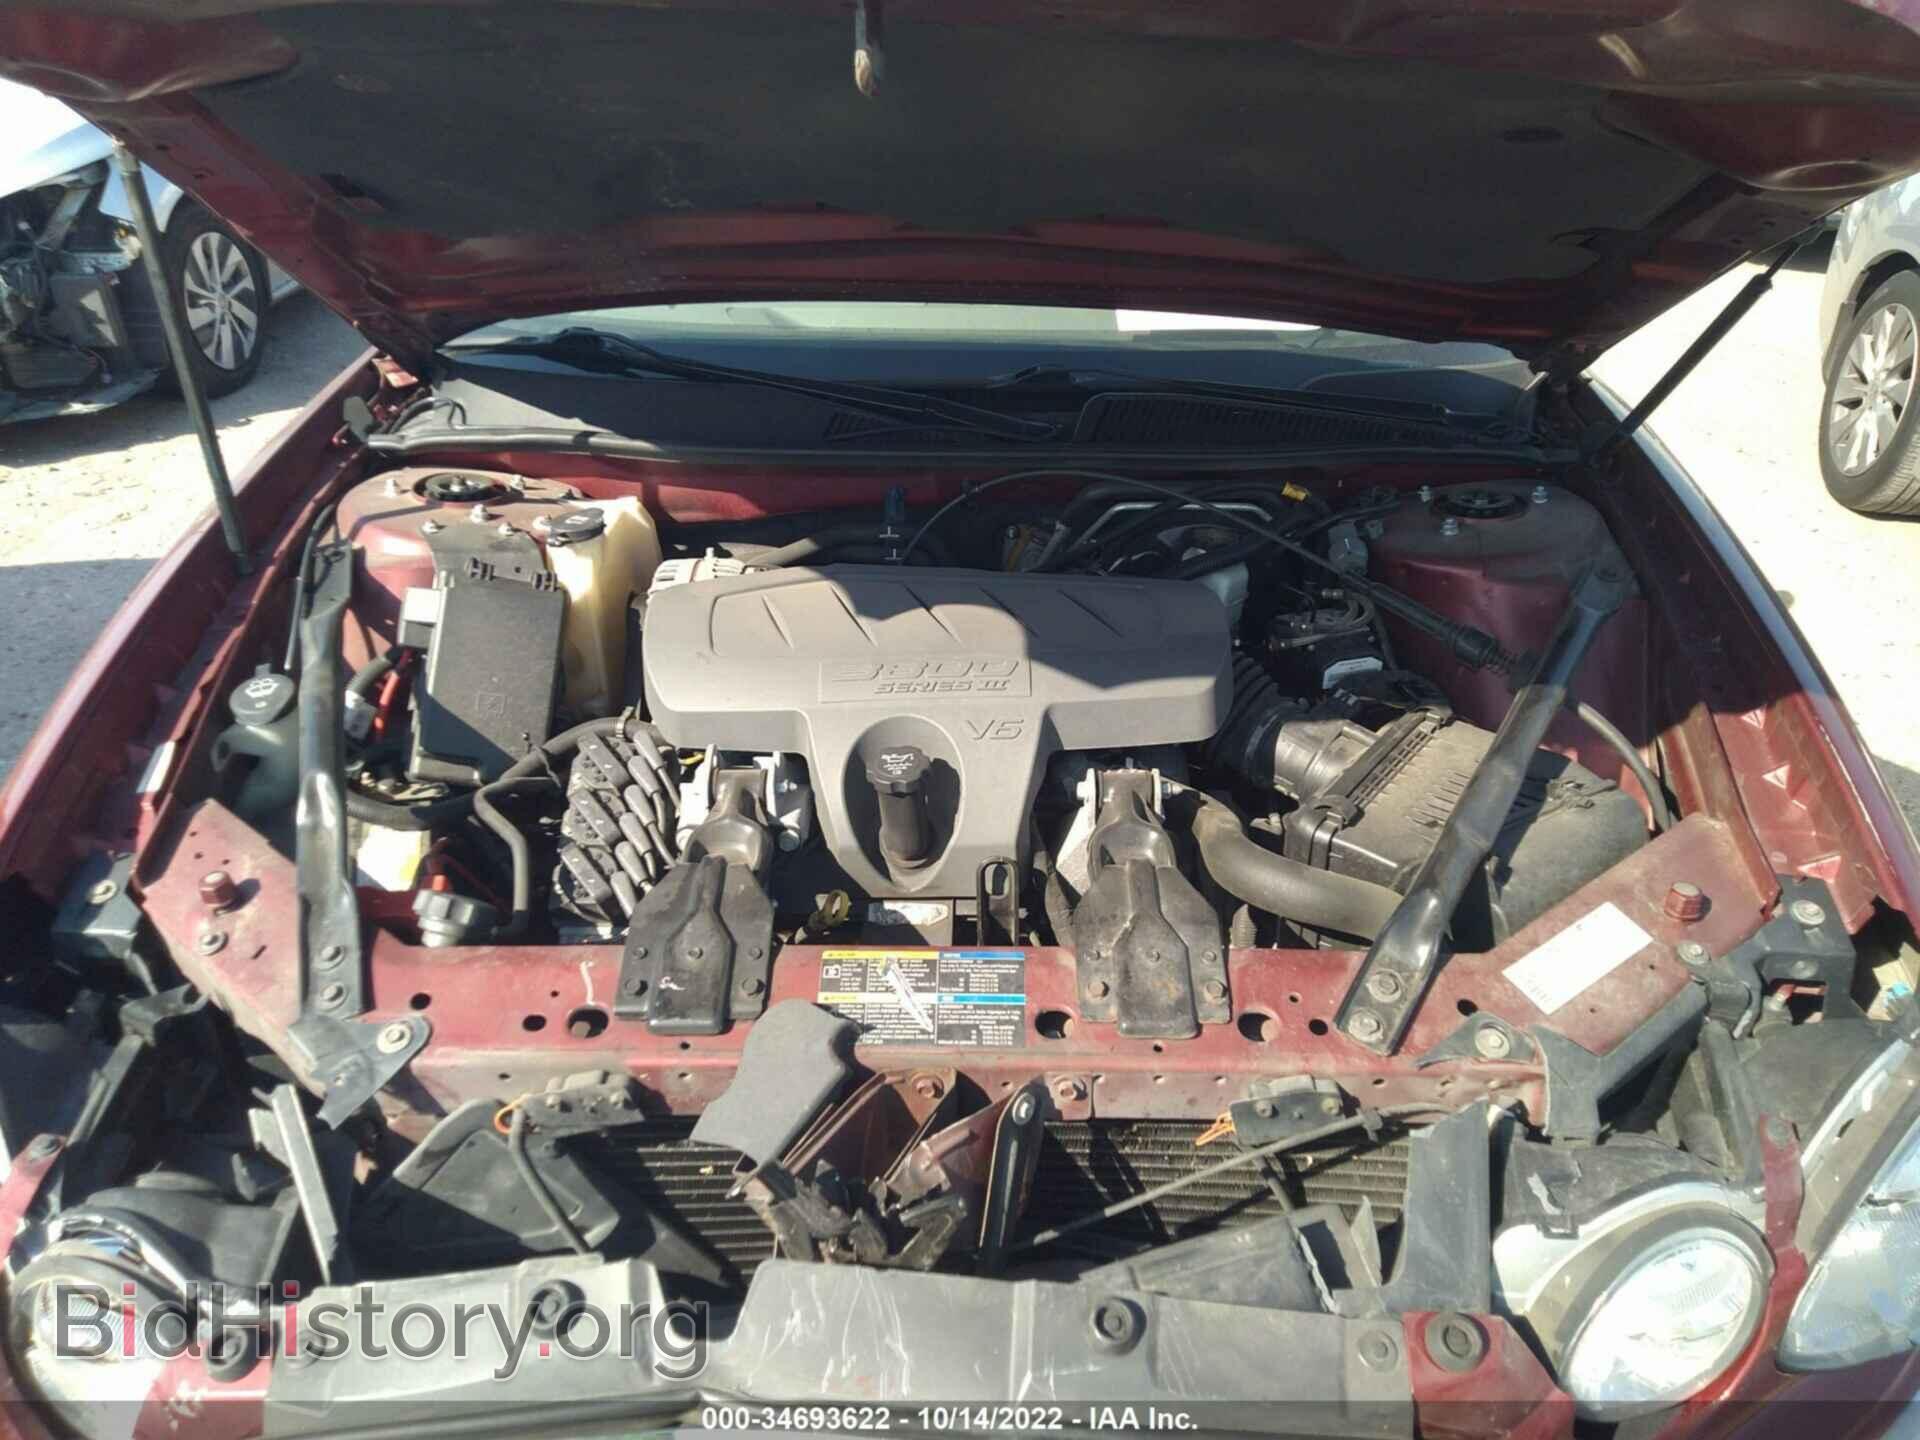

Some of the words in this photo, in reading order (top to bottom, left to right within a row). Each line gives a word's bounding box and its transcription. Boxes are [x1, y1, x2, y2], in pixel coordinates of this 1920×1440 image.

[873, 679, 974, 695] SERIES
[976, 678, 1011, 692] III
[966, 718, 1025, 740] V6
